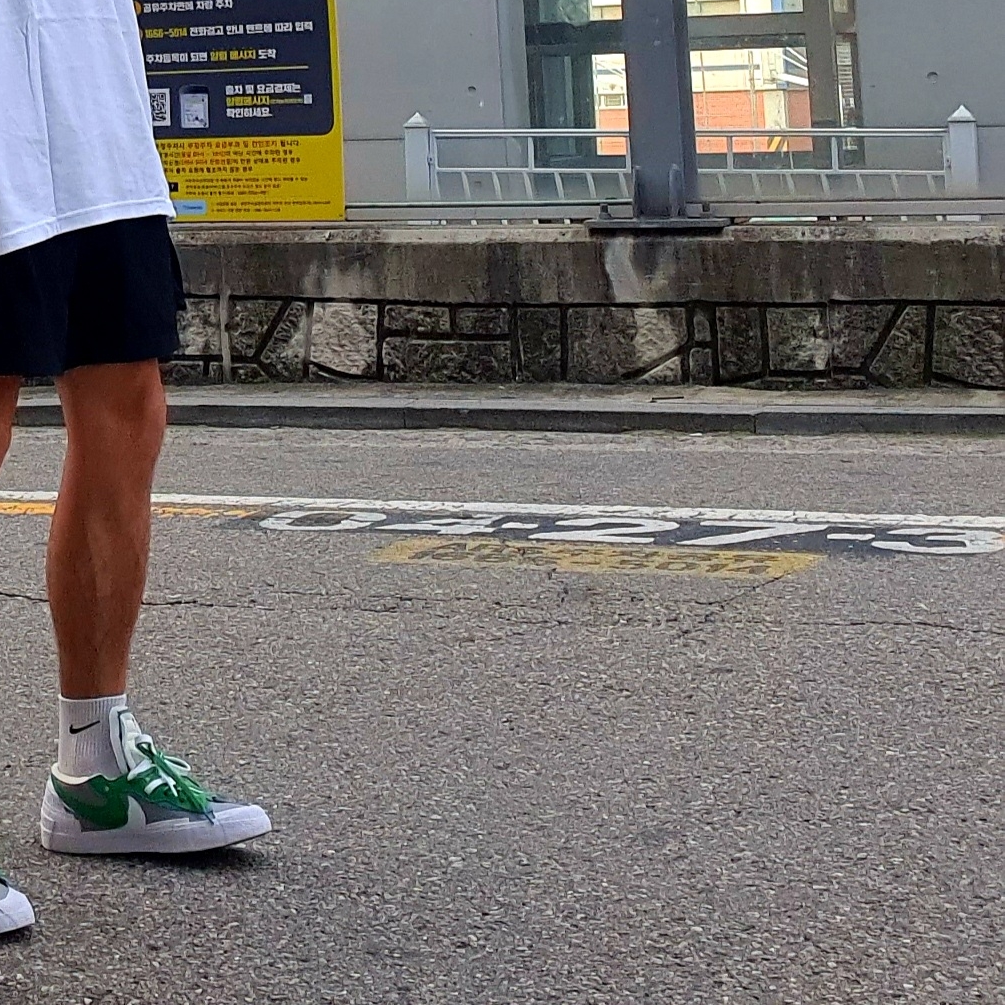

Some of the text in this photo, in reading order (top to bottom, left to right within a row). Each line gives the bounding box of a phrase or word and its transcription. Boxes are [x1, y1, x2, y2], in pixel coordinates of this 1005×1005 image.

[215, 0, 233, 9] 주차
[226, 24, 244, 35] 안내
[274, 22, 293, 32] 따라
[258, 48, 276, 59] 도착
